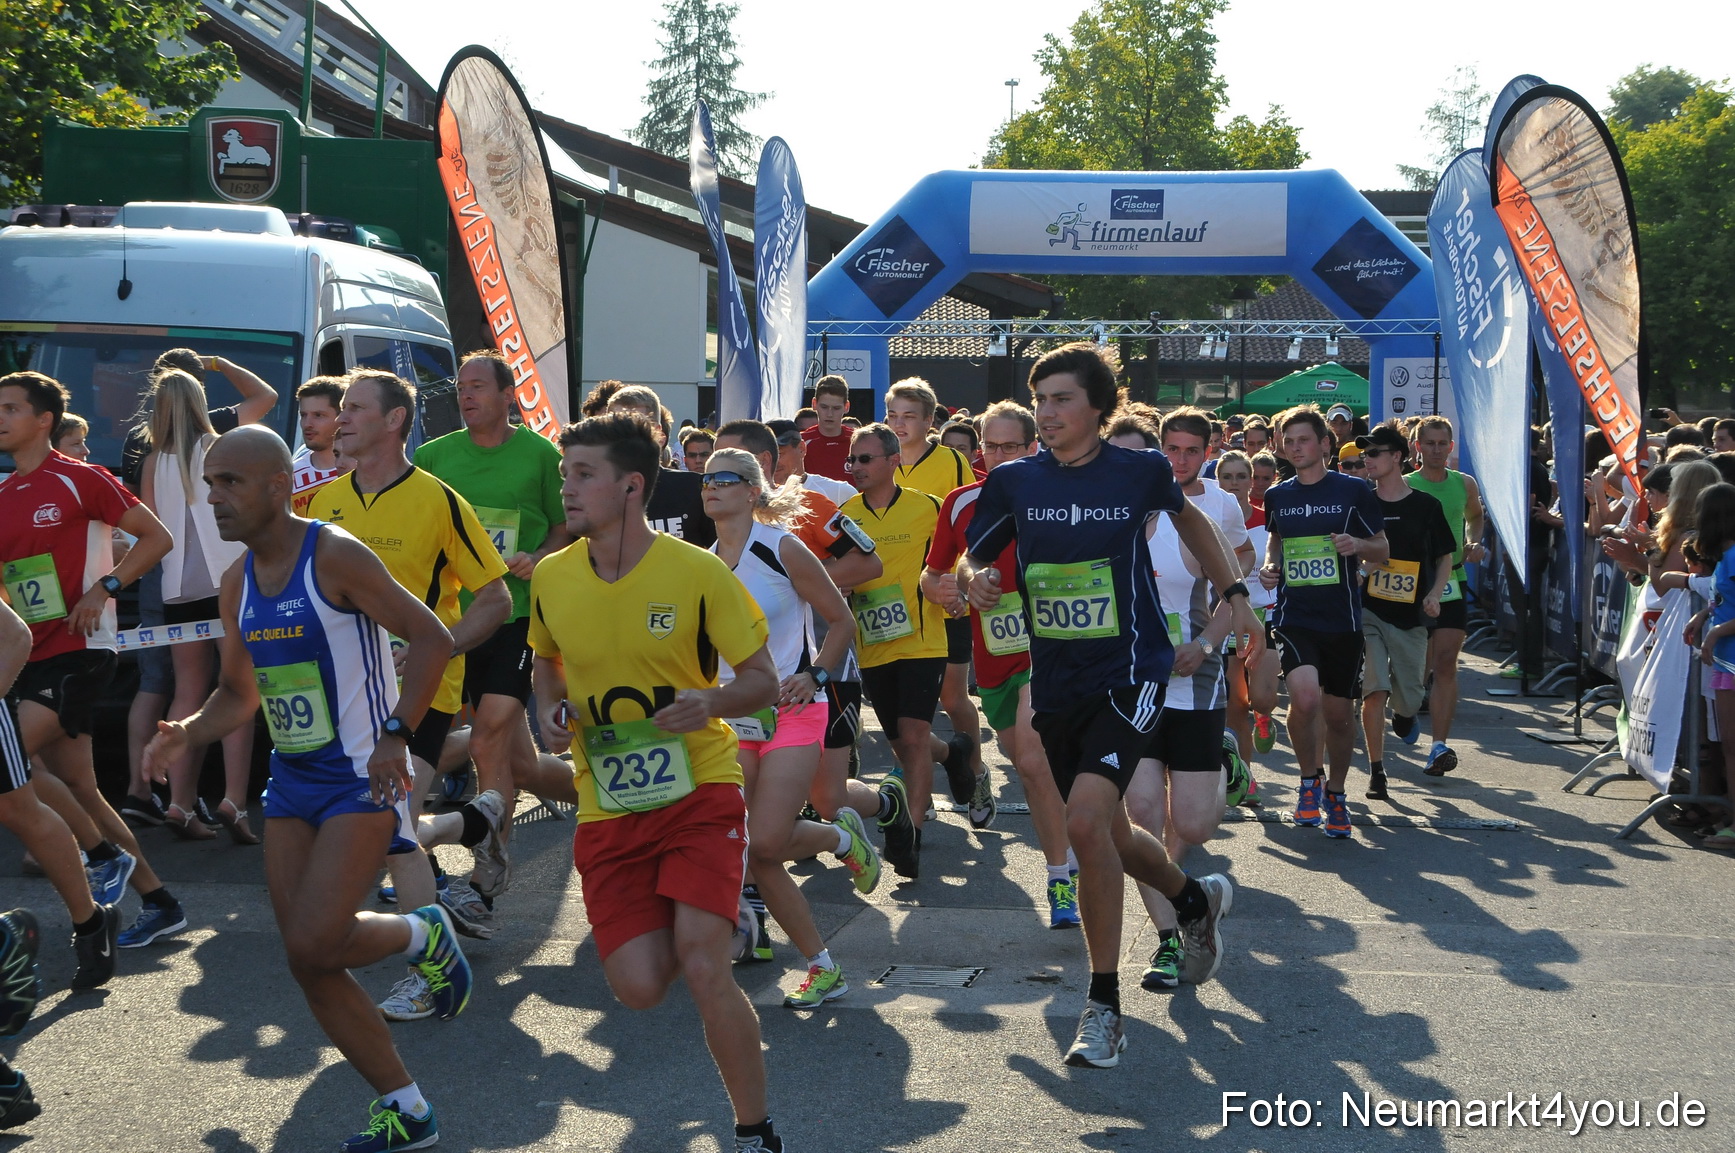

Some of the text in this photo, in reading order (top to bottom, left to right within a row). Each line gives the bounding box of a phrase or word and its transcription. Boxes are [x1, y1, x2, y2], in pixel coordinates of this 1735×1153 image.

[229, 182, 260, 194] 1628
[1122, 200, 1161, 210] Fischer
[1092, 221, 1208, 242] firmenlauf
[1091, 243, 1139, 251] neumarkt
[868, 258, 930, 272] Fischer
[1353, 259, 1370, 268] das
[873, 271, 924, 279] AUTOMOBILE
[1027, 506, 1130, 521] EURO POLES
[1280, 504, 1343, 517] EURO POLES
[357, 536, 403, 547] ANGLER
[871, 533, 911, 543] ANGLER
[1288, 559, 1336, 580] 5088
[1371, 570, 1415, 593] 1133
[17, 580, 45, 608] 12
[276, 598, 305, 611] HEITEC
[858, 603, 907, 632] 1298
[1035, 597, 1110, 629] 5087
[650, 614, 672, 629] FC
[245, 625, 304, 642] LAC QUELLE
[266, 694, 314, 732] 599
[602, 748, 676, 792] 232
